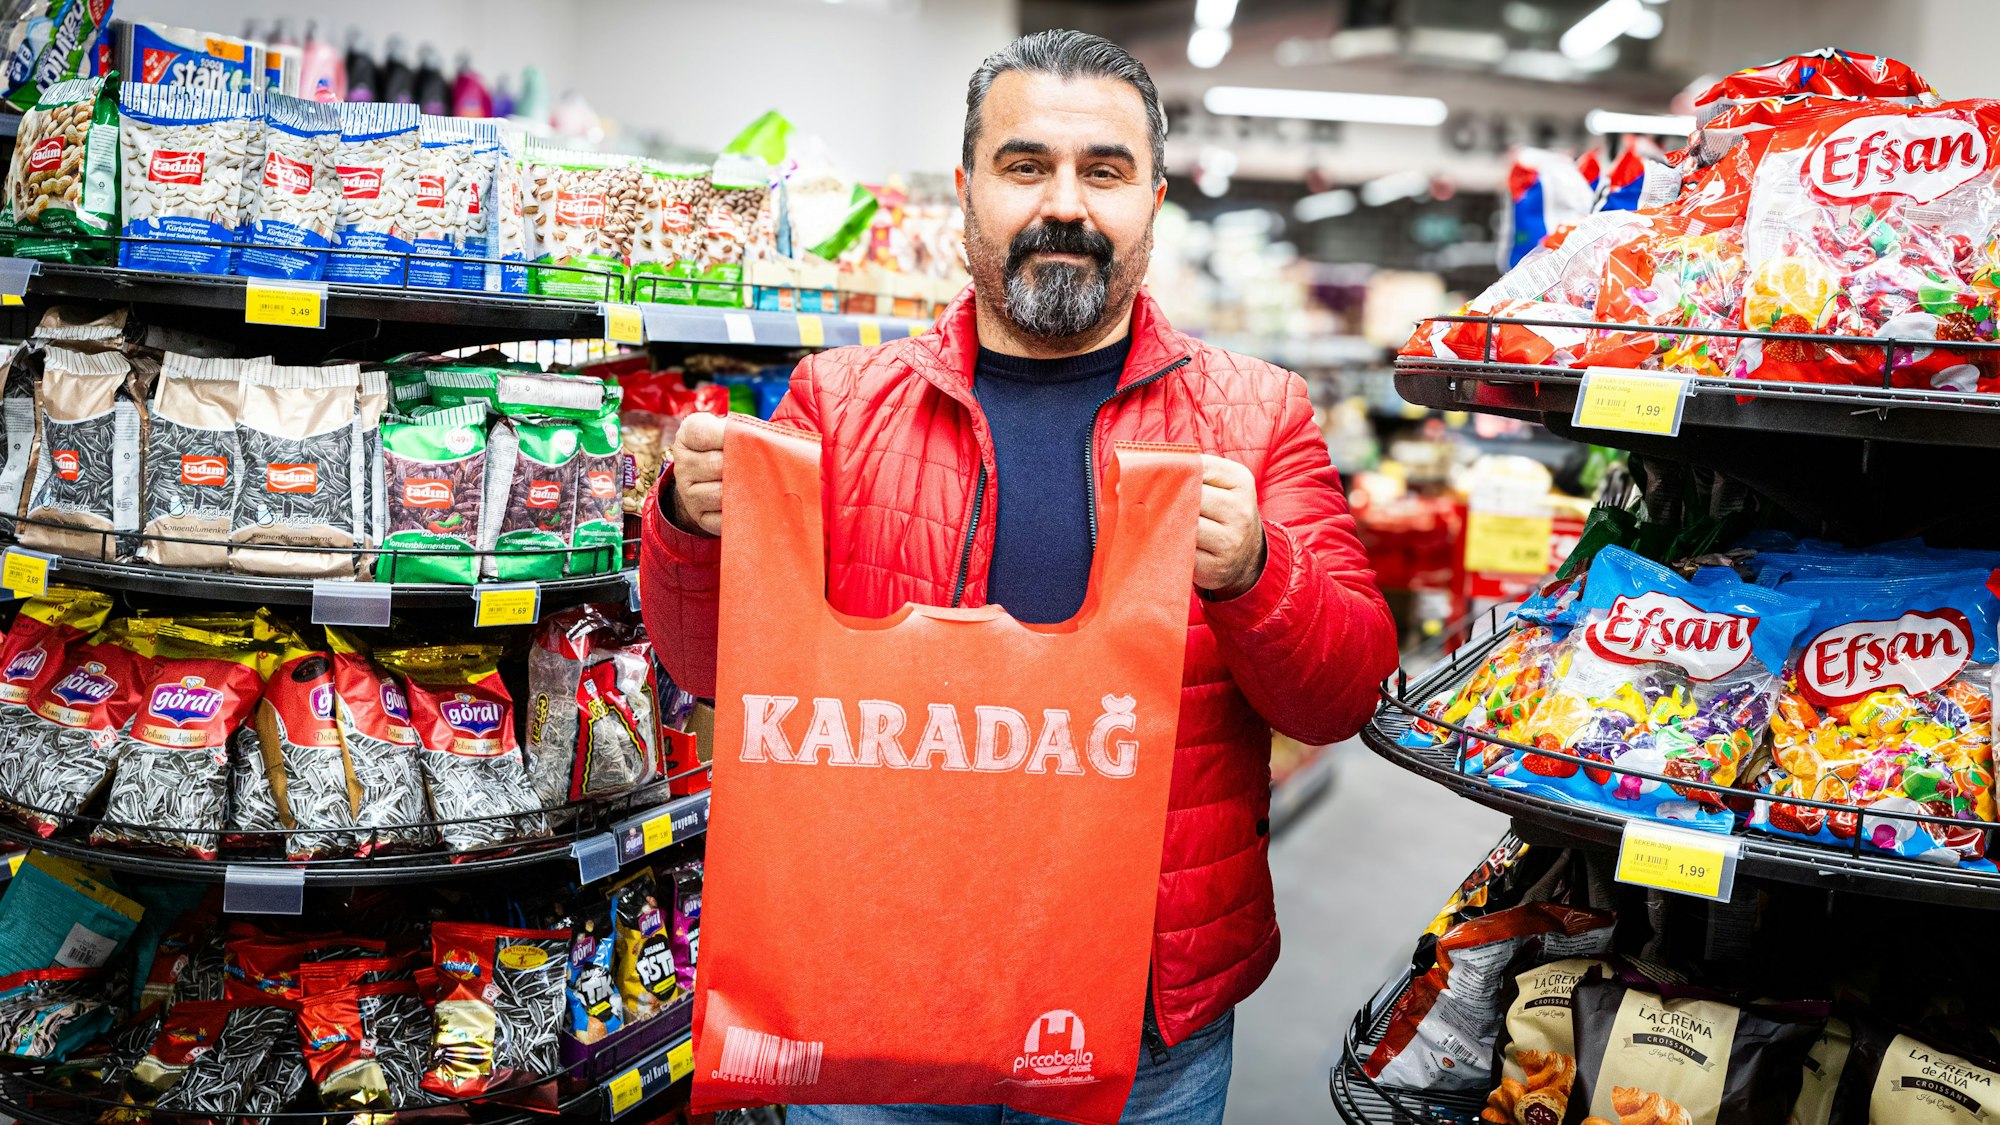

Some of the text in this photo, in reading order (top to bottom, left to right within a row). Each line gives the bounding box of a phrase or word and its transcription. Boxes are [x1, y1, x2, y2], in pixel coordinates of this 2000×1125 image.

[171, 60, 231, 92] stark
[152, 157, 202, 174] tadım
[1821, 130, 1980, 190] Efşan
[342, 174, 381, 189] adım
[166, 224, 209, 236] Kürbiskerne
[291, 307, 310, 317] 3,49
[53, 458, 77, 471] dım
[184, 463, 226, 477] tadım
[269, 471, 315, 485] tadım
[405, 486, 450, 501] tadım
[530, 489, 559, 501] tadım
[163, 523, 229, 535] Sonnenblumenker
[388, 538, 461, 550] Sonnenblumenkerne
[512, 607, 527, 616] 1,69
[1603, 601, 1746, 656] Efşan
[1814, 628, 1961, 689] Efşan
[153, 688, 216, 714] göral
[385, 687, 407, 714] gör
[449, 699, 501, 724] göral
[739, 693, 1140, 778] KARADAĞ
[671, 811, 698, 832] uruyemiş
[637, 949, 676, 986] FISTI
[1534, 974, 1581, 990] LA CREM
[1552, 986, 1573, 995] ALVA
[1534, 998, 1570, 1006] CROISSAN
[1639, 1007, 1713, 1039] LA CREMA
[1651, 1025, 1694, 1044] de ALVA
[1647, 1036, 1697, 1058] CROISSANT
[1013, 1050, 1094, 1073] piccobello
[1648, 1048, 1686, 1066] High Quality
[1069, 1063, 1092, 1075] plast
[1909, 1048, 1992, 1087] LA CREMA
[1921, 1065, 1969, 1090] de ALVA
[1915, 1079, 1969, 1104] CROISSANT
[1916, 1093, 1937, 1105] High
